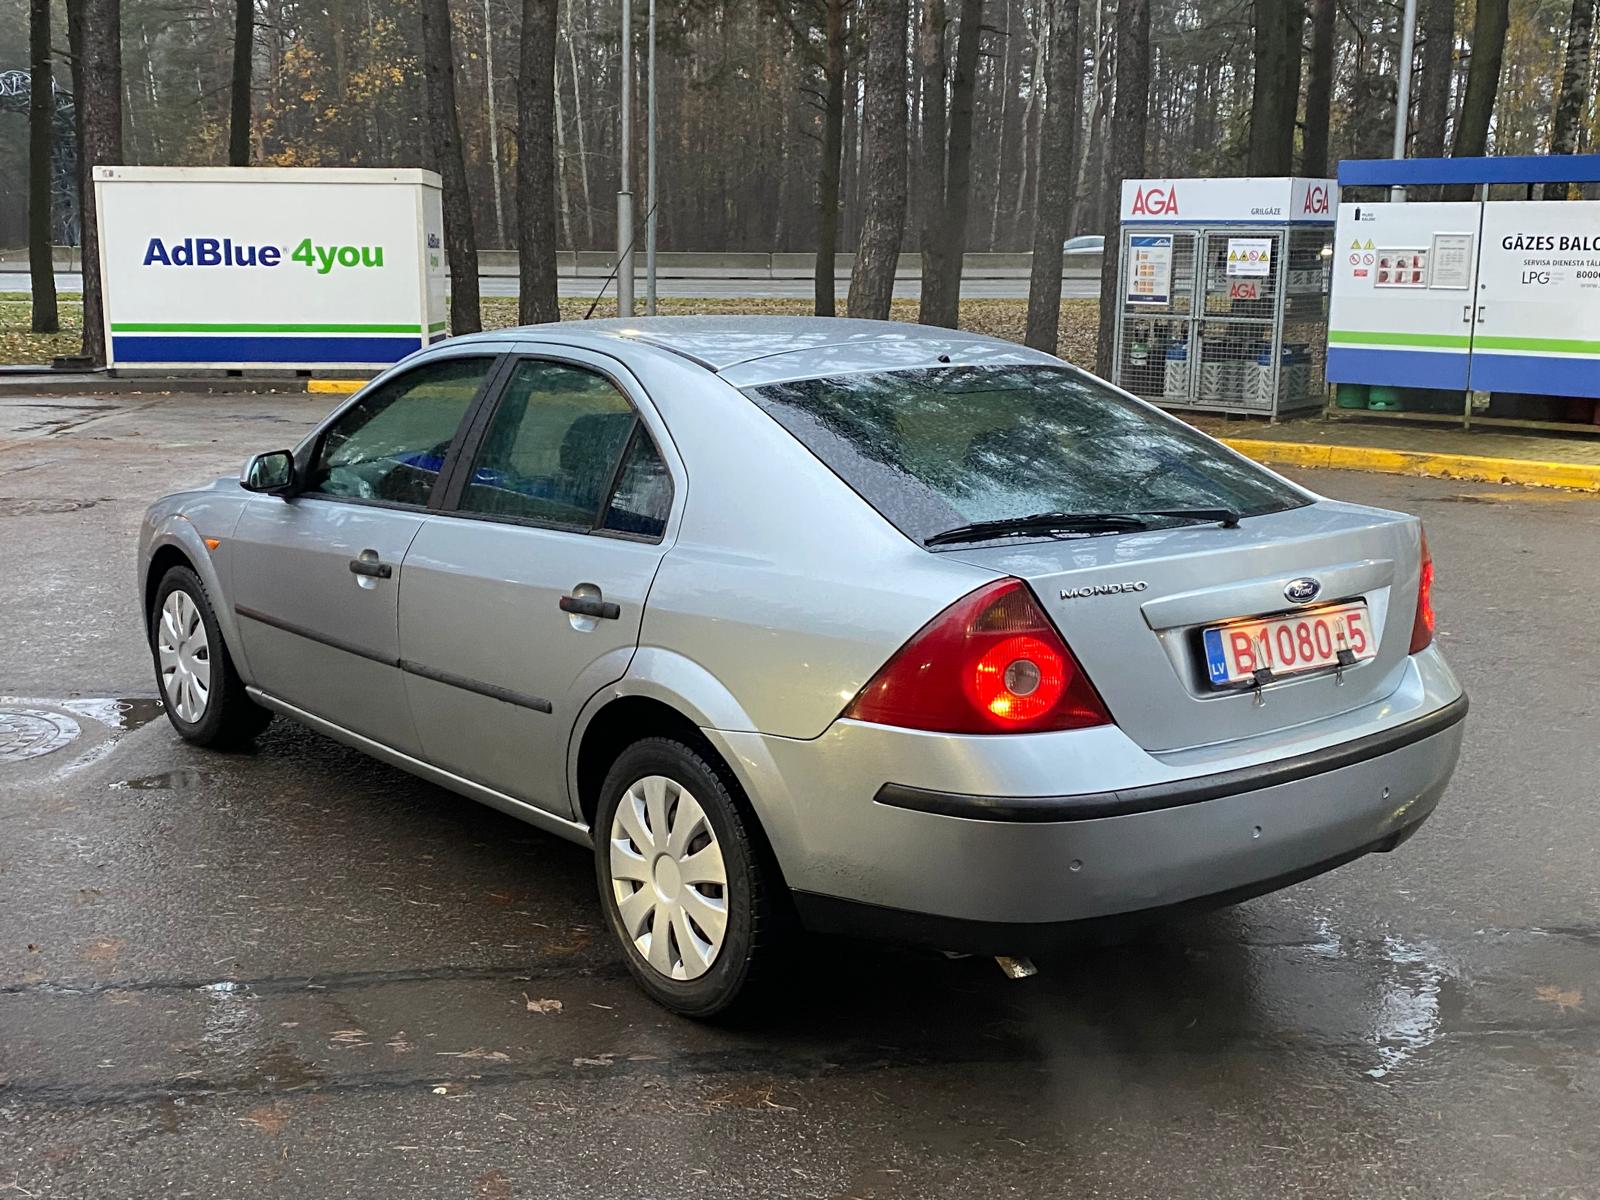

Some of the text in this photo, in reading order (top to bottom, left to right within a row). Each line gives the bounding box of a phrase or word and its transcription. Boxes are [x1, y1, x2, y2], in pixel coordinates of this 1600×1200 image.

[1132, 184, 1178, 215] AGA
[1303, 183, 1329, 214] AGA
[1502, 232, 1555, 251] GĀZES
[143, 238, 384, 274] AdBlue 4you
[1576, 270, 1600, 279] 8000
[1229, 282, 1257, 298] AGA
[1059, 580, 1149, 600] MONDEO
[1287, 581, 1316, 600] Ford
[1211, 662, 1226, 676] LV
